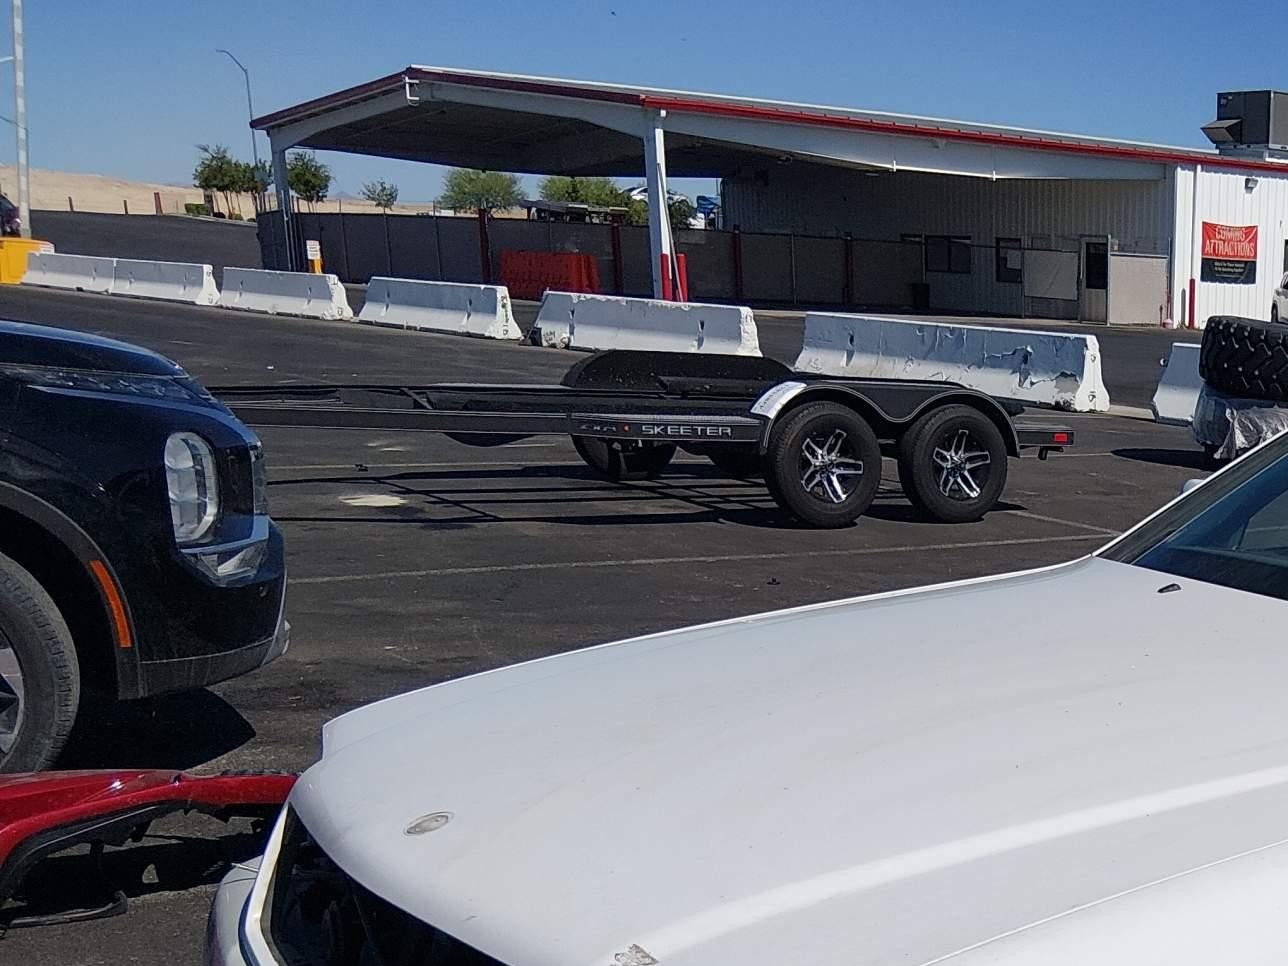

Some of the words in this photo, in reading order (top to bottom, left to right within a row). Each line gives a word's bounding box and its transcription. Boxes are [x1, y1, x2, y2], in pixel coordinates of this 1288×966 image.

[1215, 225, 1246, 241] COMING
[1205, 239, 1255, 257] ATTRACTIONS
[641, 425, 731, 436] SKEETER
